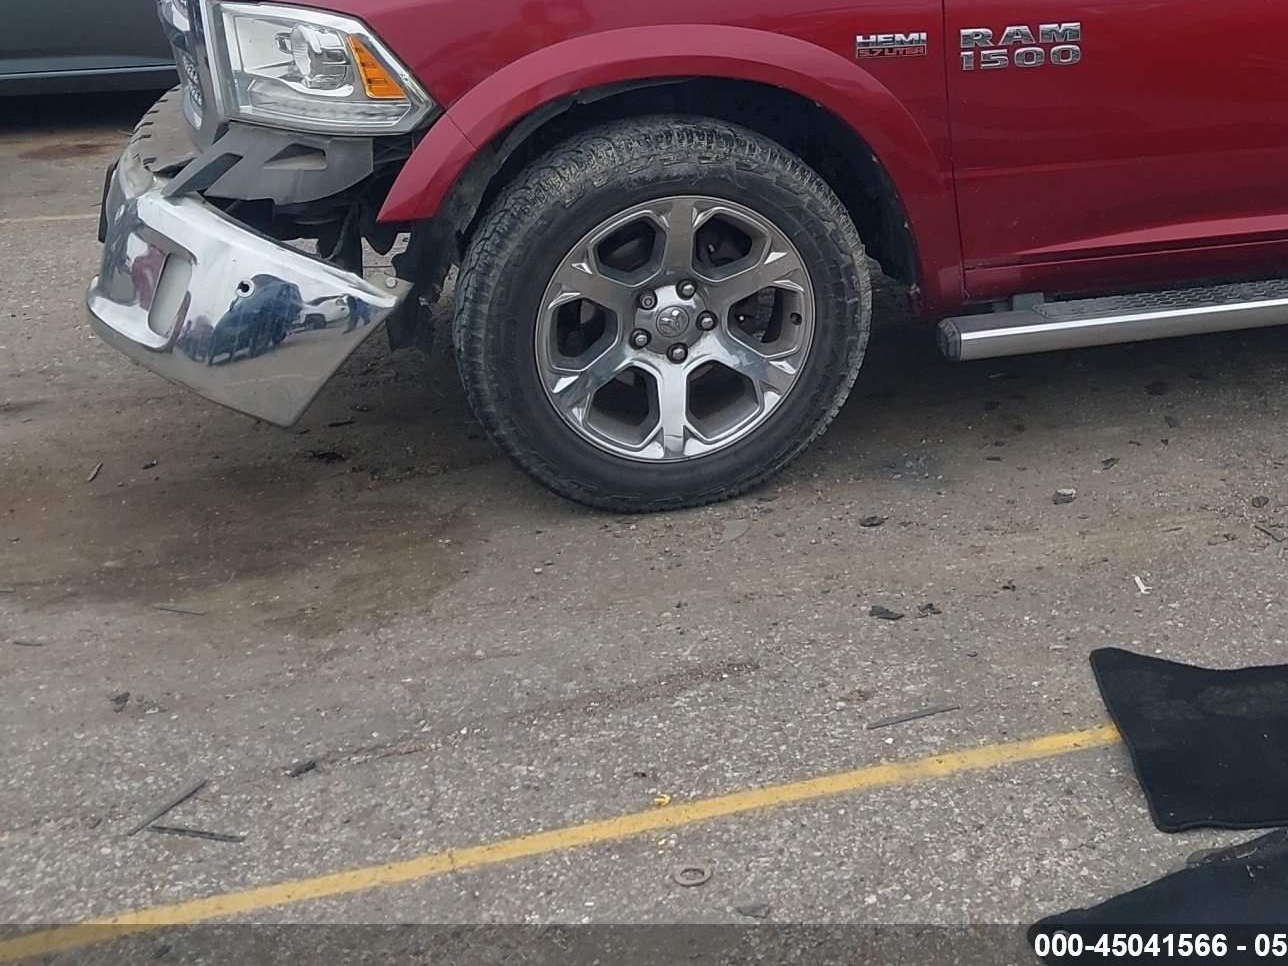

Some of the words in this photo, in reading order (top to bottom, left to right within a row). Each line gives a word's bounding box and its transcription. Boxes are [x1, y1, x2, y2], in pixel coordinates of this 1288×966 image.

[856, 32, 927, 47] HEMI
[960, 22, 1081, 48] RAM
[858, 48, 883, 57] 5.7
[884, 46, 925, 56] LITER
[960, 45, 1081, 71] 1500
